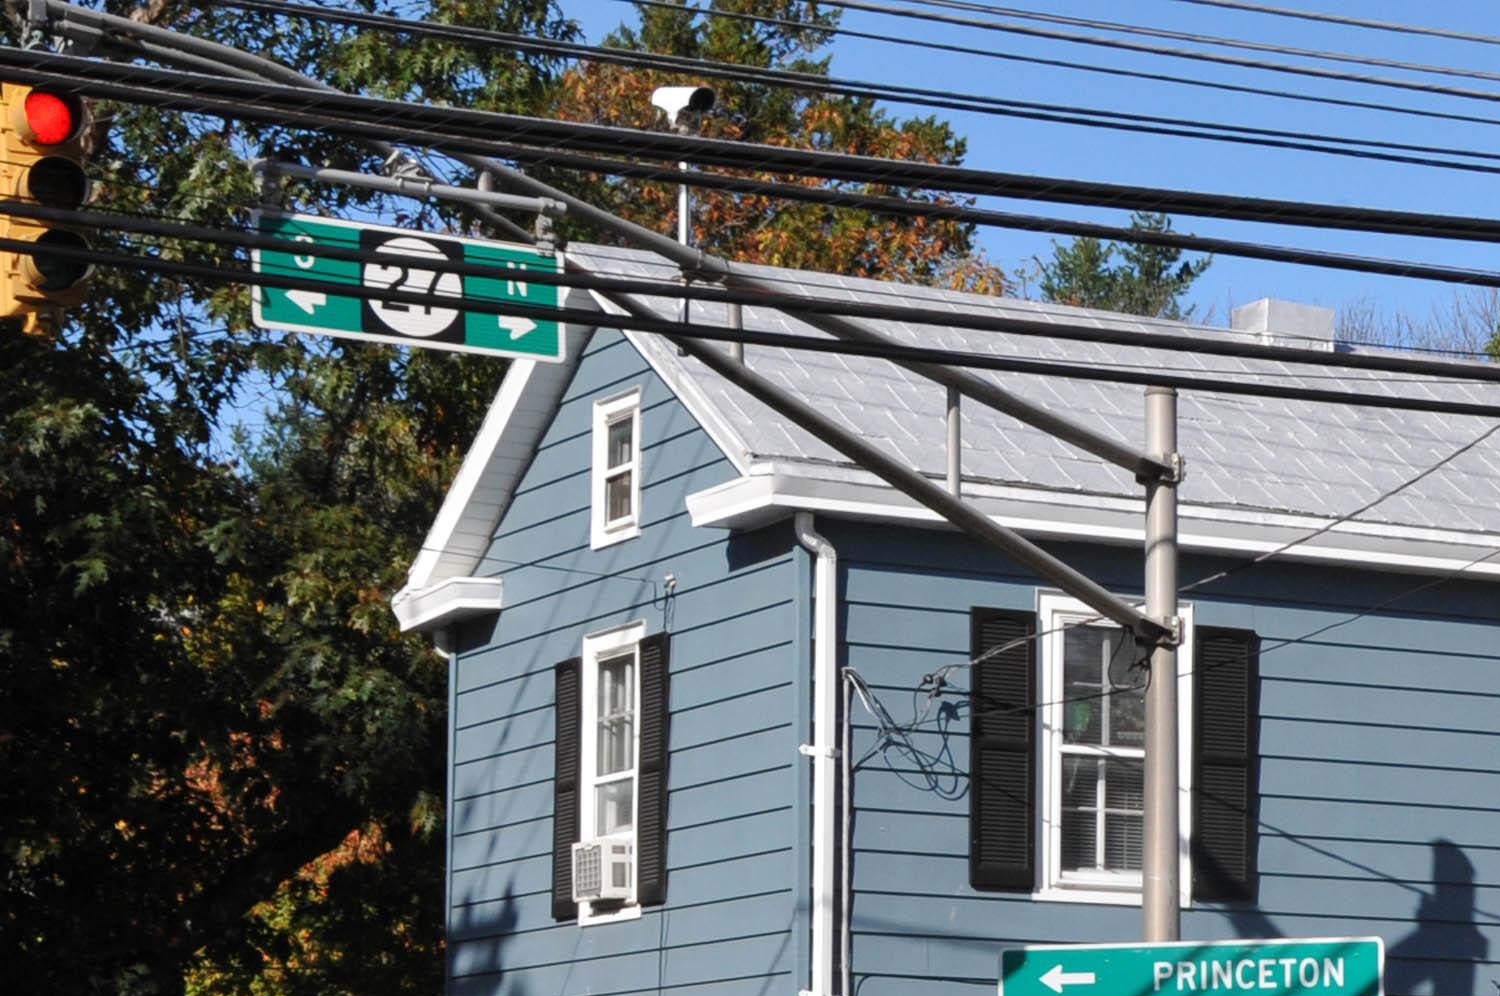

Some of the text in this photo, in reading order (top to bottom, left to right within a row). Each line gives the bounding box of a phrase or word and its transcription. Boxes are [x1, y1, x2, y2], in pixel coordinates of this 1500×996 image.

[380, 255, 445, 315] 27
[506, 261, 528, 298] N
[1153, 957, 1345, 991] PRINCETON
